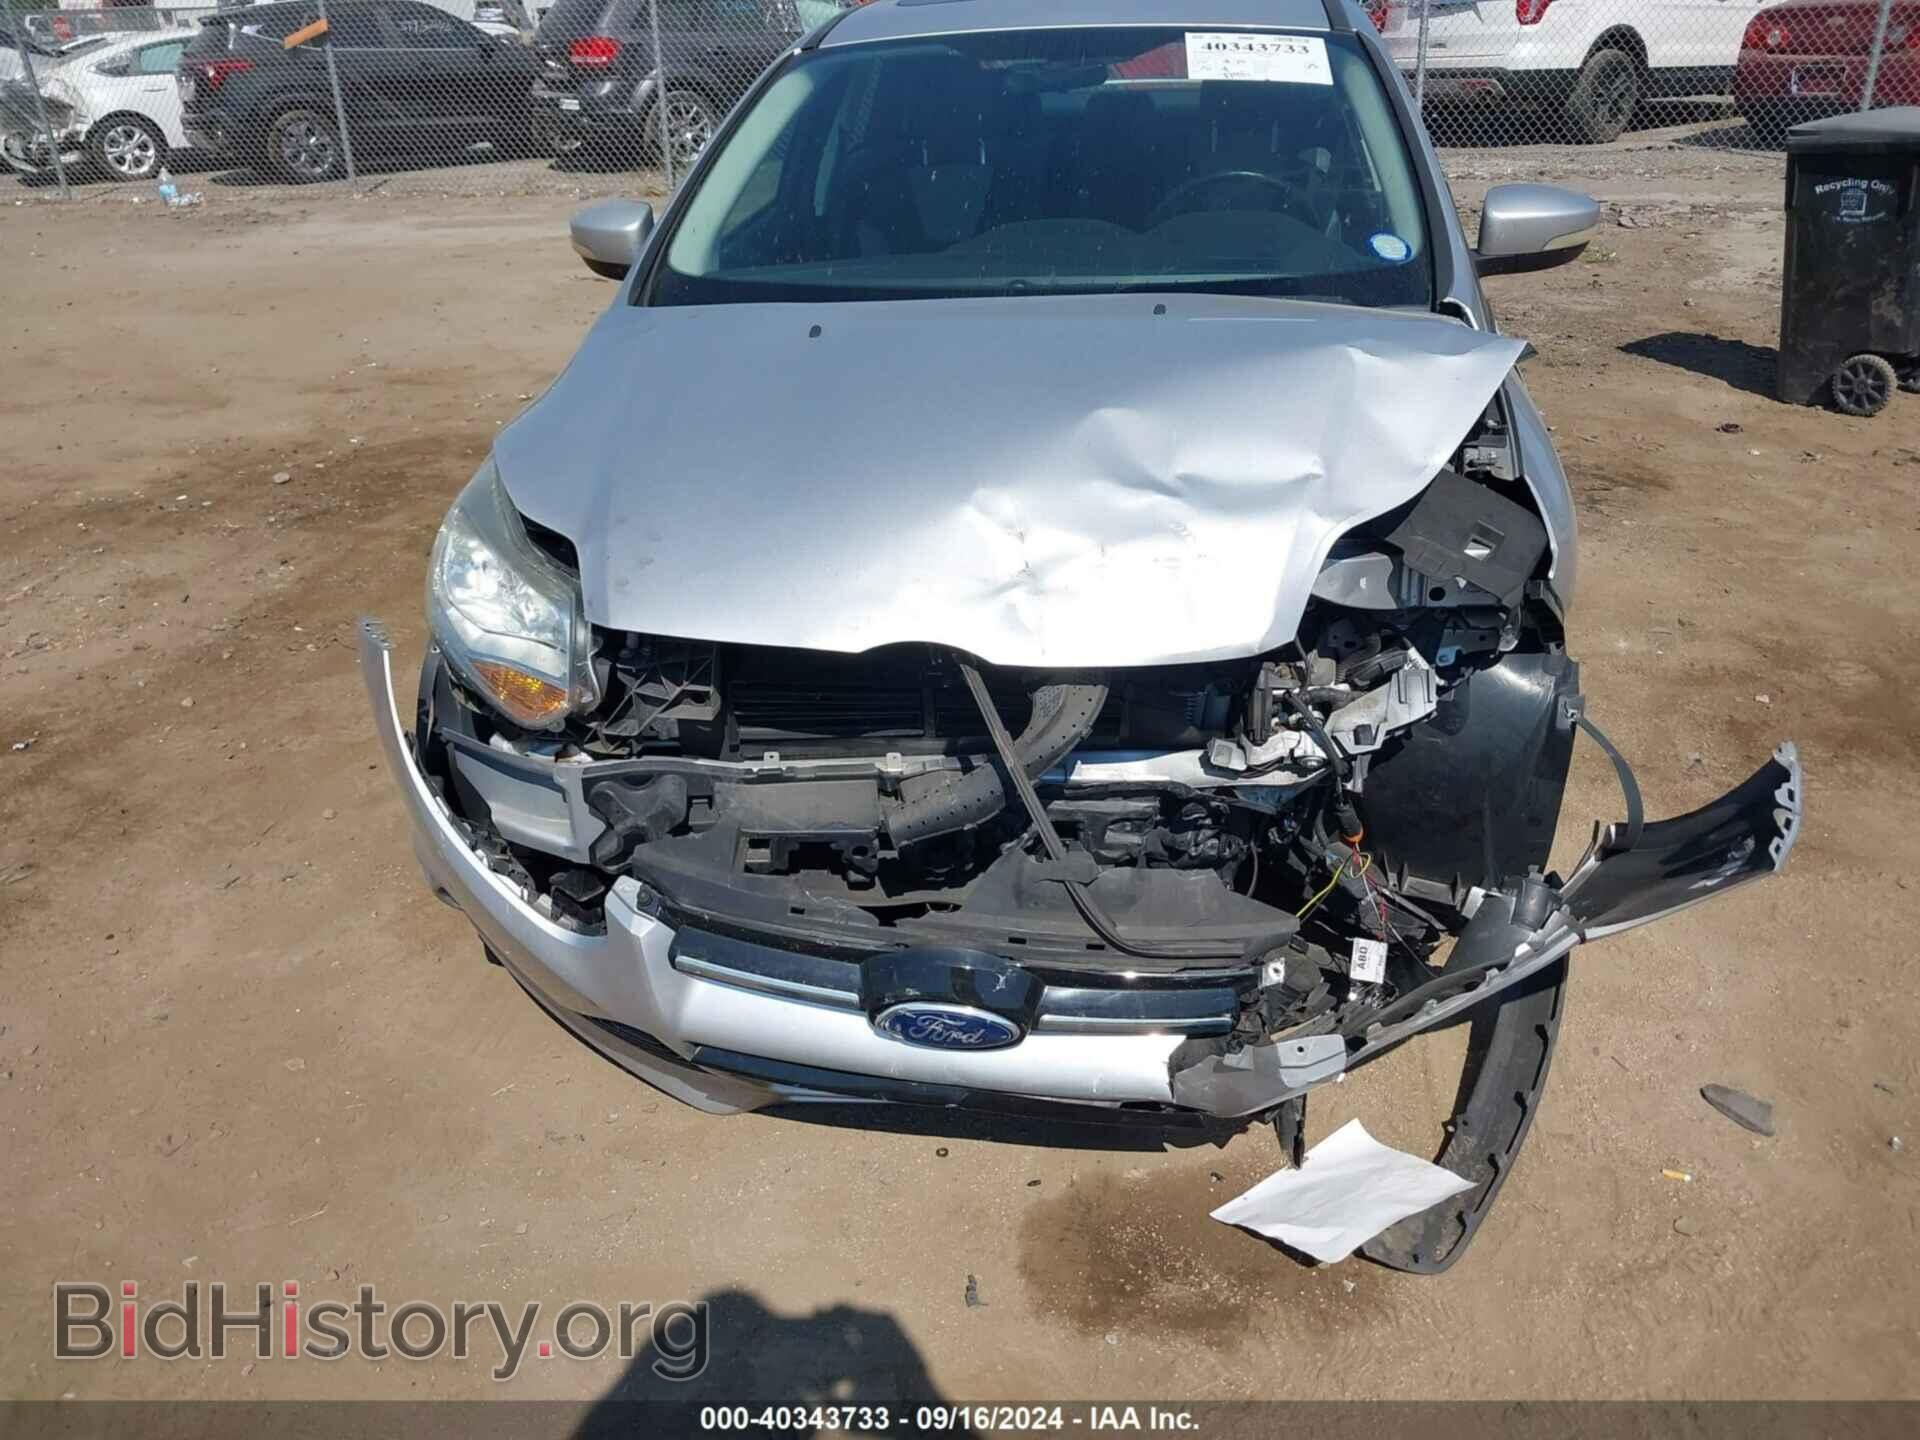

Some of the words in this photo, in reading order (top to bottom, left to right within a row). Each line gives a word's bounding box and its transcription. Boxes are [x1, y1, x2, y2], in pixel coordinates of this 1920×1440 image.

[1202, 42, 1310, 54] 40343733
[1814, 178, 1869, 195] Recycling
[908, 1014, 985, 1044] Ford
